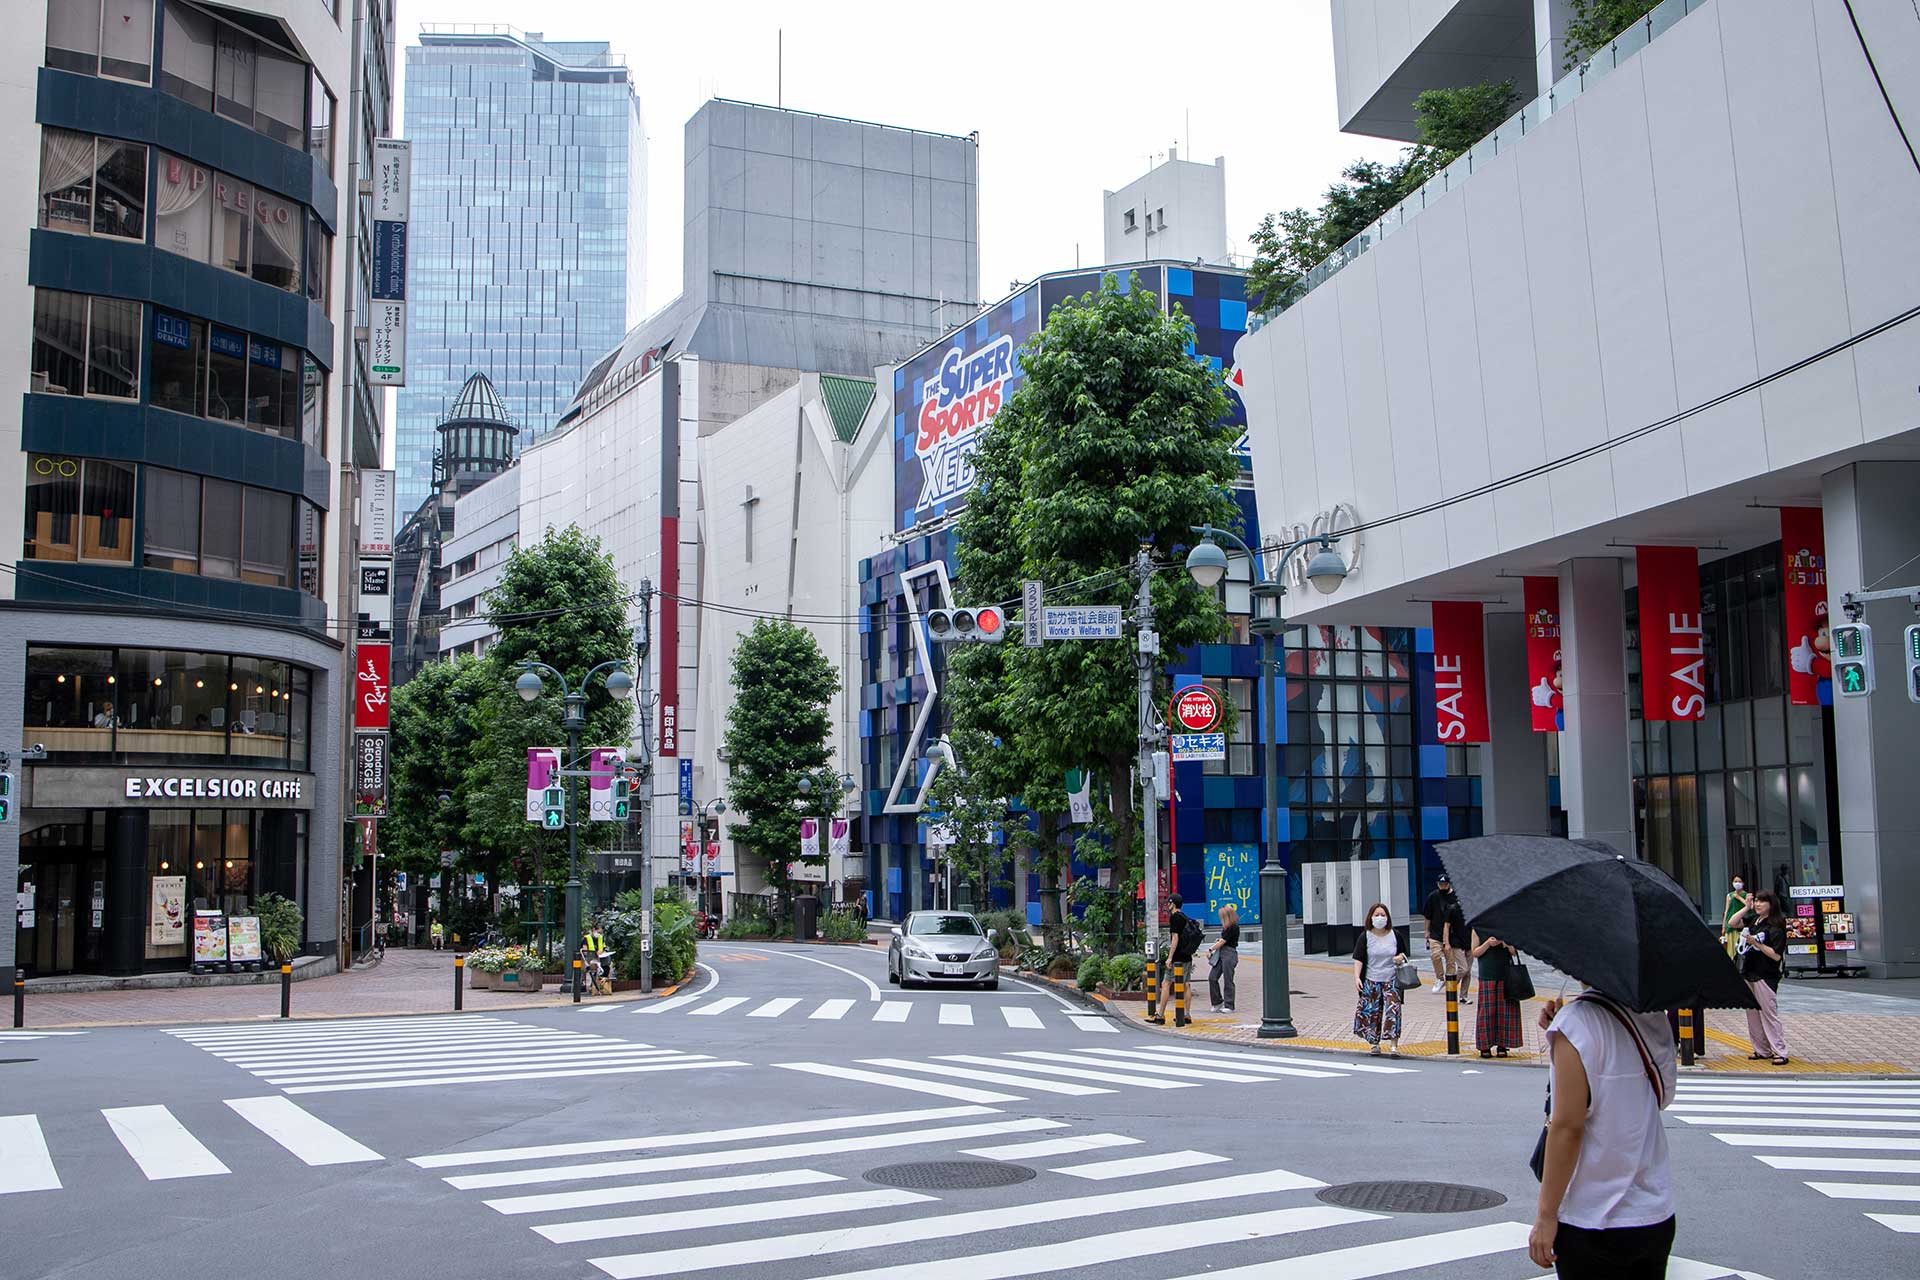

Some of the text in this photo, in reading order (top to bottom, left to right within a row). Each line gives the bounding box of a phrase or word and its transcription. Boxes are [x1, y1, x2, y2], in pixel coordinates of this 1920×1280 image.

[391, 234, 404, 274] orthodontic
[390, 275, 403, 294] clinic
[156, 331, 187, 346] DENTAL
[211, 334, 242, 353] 公園通り
[926, 341, 1011, 408] THE SUPER
[918, 380, 1003, 452] SPORTS
[373, 474, 385, 541] PASTEL ATELIER
[1028, 583, 1038, 643] スクランブル交差点
[1047, 610, 1118, 625] 勤労福祉会館前
[362, 628, 375, 637] 2F
[1049, 625, 1117, 636] Worker's Welfare Hall
[1669, 613, 1706, 719] SALE
[1433, 654, 1466, 741] SALE
[1181, 703, 1213, 718] 消火栓
[664, 705, 675, 749] 無印良品
[1186, 735, 1224, 748] セキネ
[363, 738, 374, 789] GEORGES
[374, 738, 384, 789] Grandma's
[126, 777, 301, 799] EXCELSIOR CAFFÉ
[1792, 888, 1840, 896] RESTAURANT
[1798, 903, 1836, 915] B1F 7F
